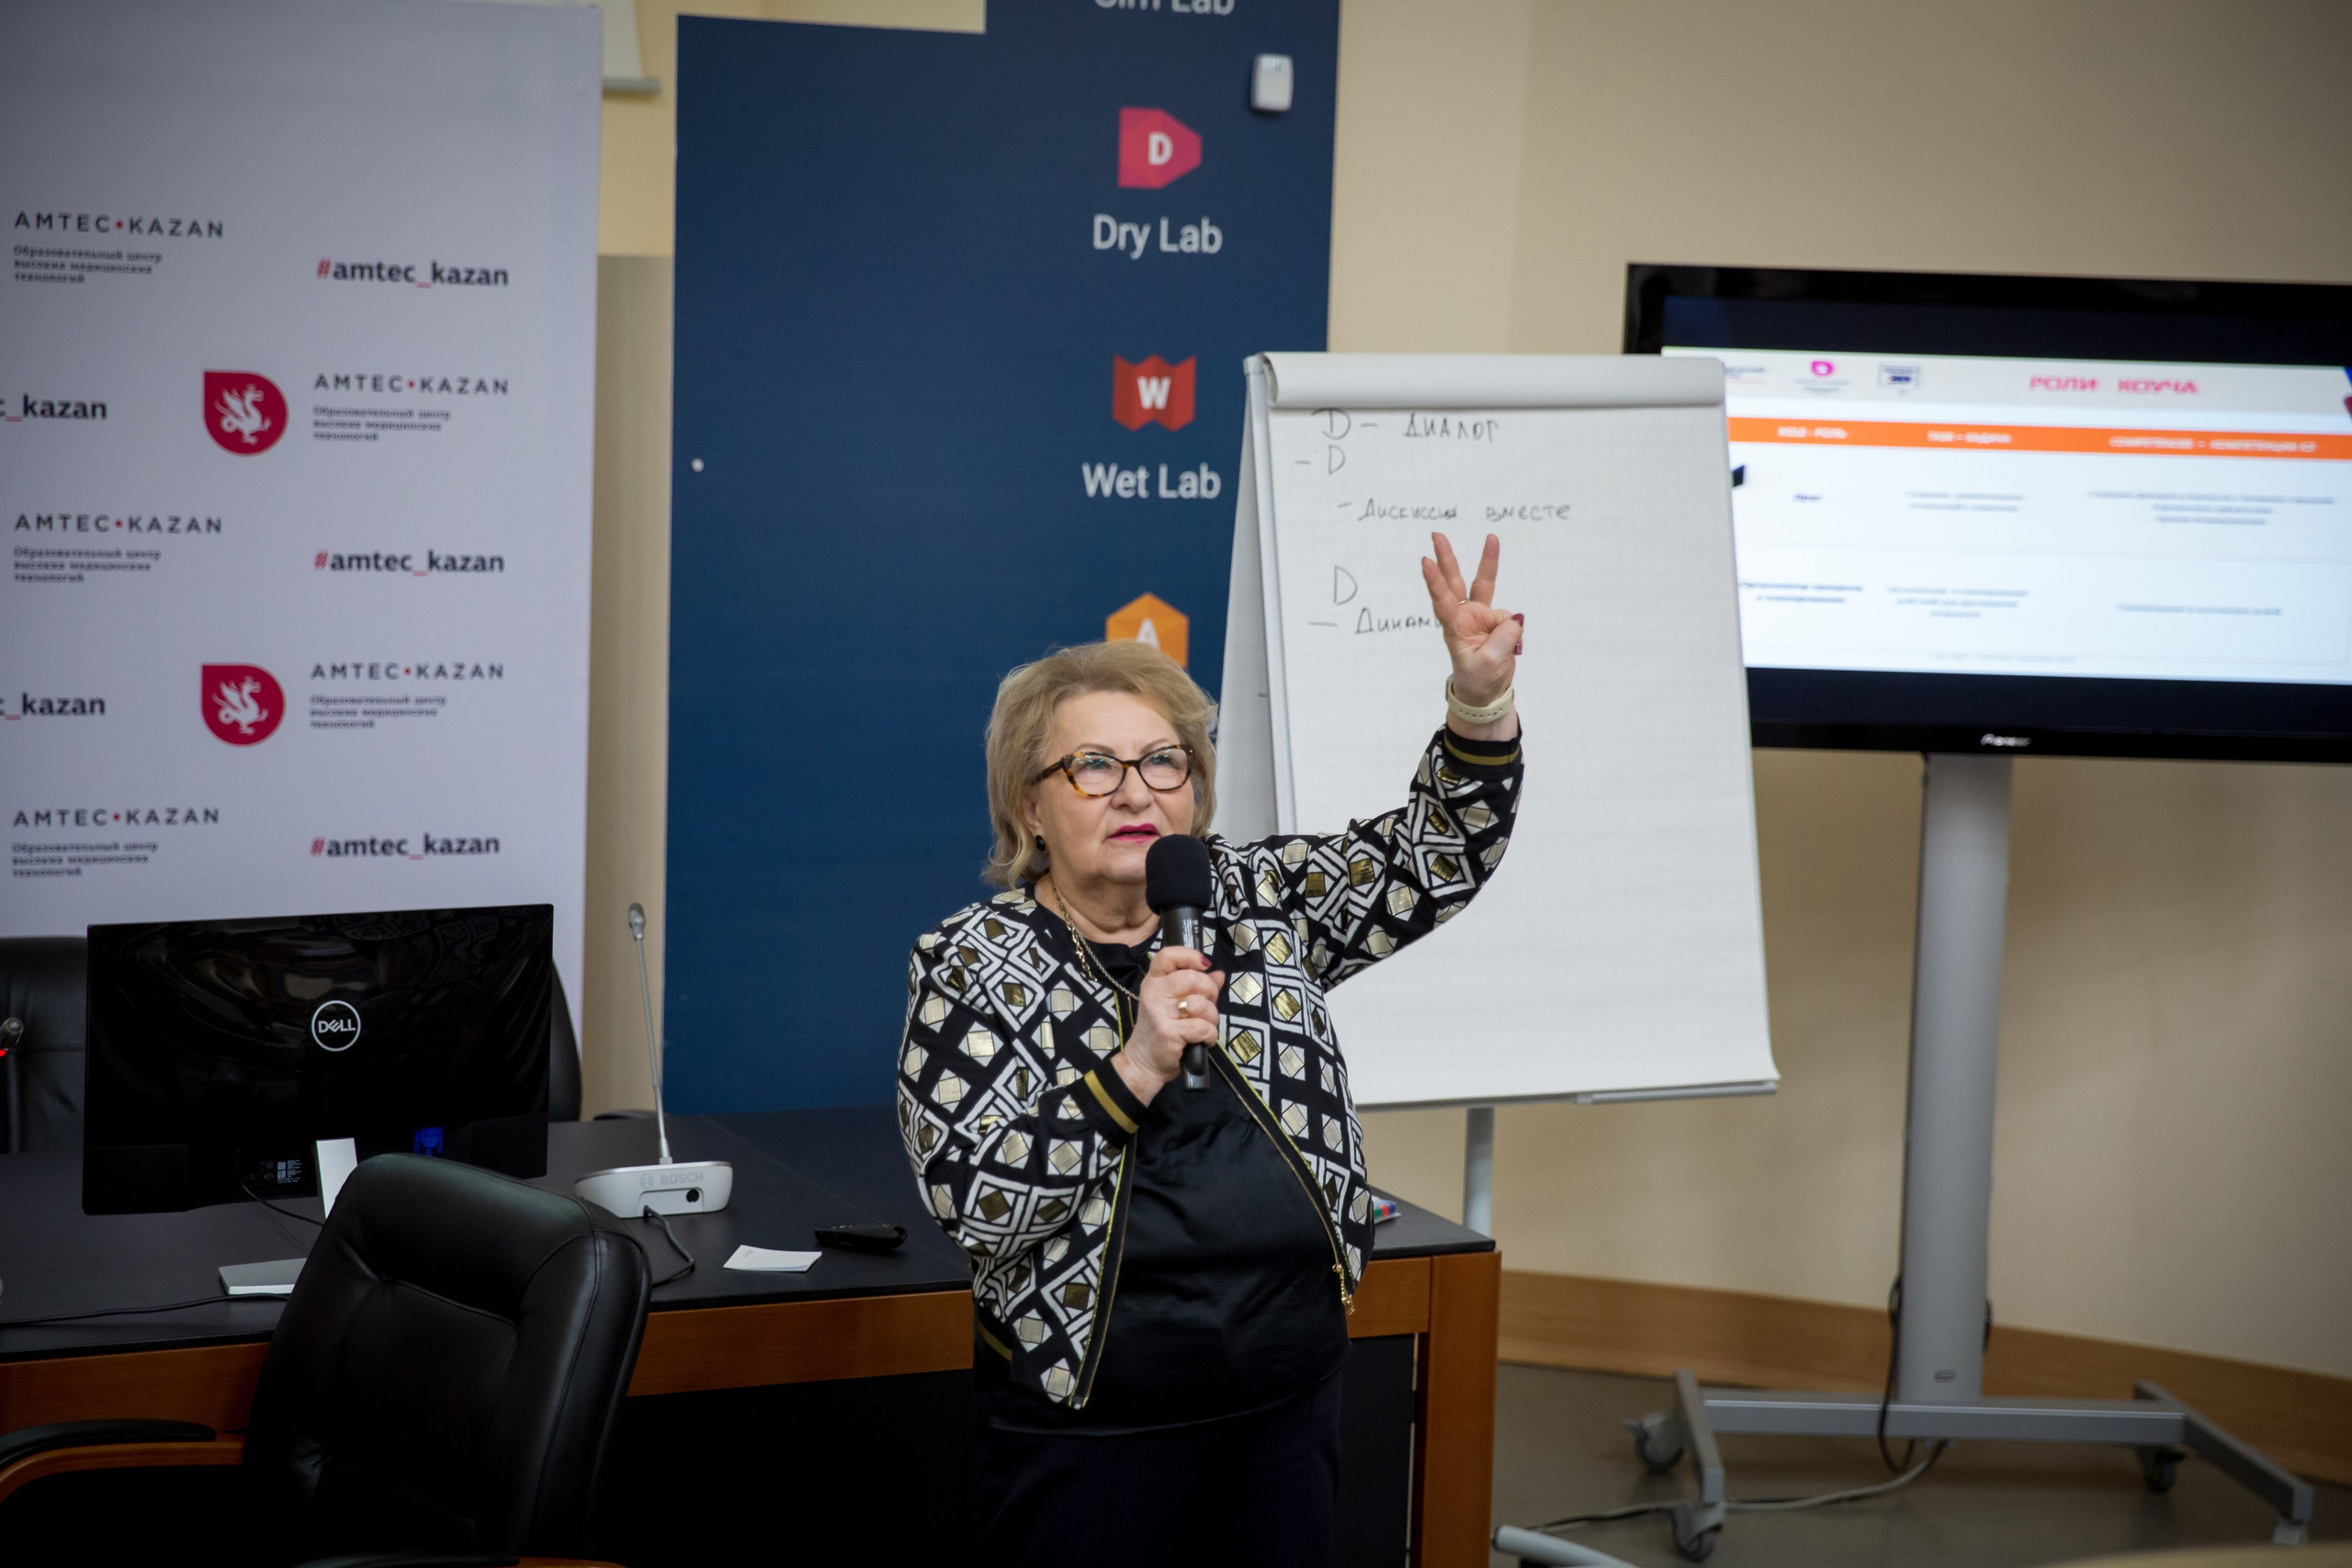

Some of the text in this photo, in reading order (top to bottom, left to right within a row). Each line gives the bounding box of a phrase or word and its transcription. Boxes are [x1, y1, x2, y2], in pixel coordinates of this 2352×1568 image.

[1148, 131, 1173, 165] D
[1093, 213, 1223, 259] Dry Lab
[317, 257, 509, 288] #amtec_kazan
[1137, 376, 1171, 410] W
[2030, 376, 2199, 395] РОЛИ КОУЧА
[1082, 462, 1221, 499] Wet Lab
[314, 547, 504, 577] #amtec_kazan
[1333, 565, 1358, 605] D
[1136, 617, 1160, 649] A
[311, 831, 500, 861] #amtec_kazan
[318, 1019, 356, 1033] DELL
[661, 1171, 704, 1185] BOSCH
